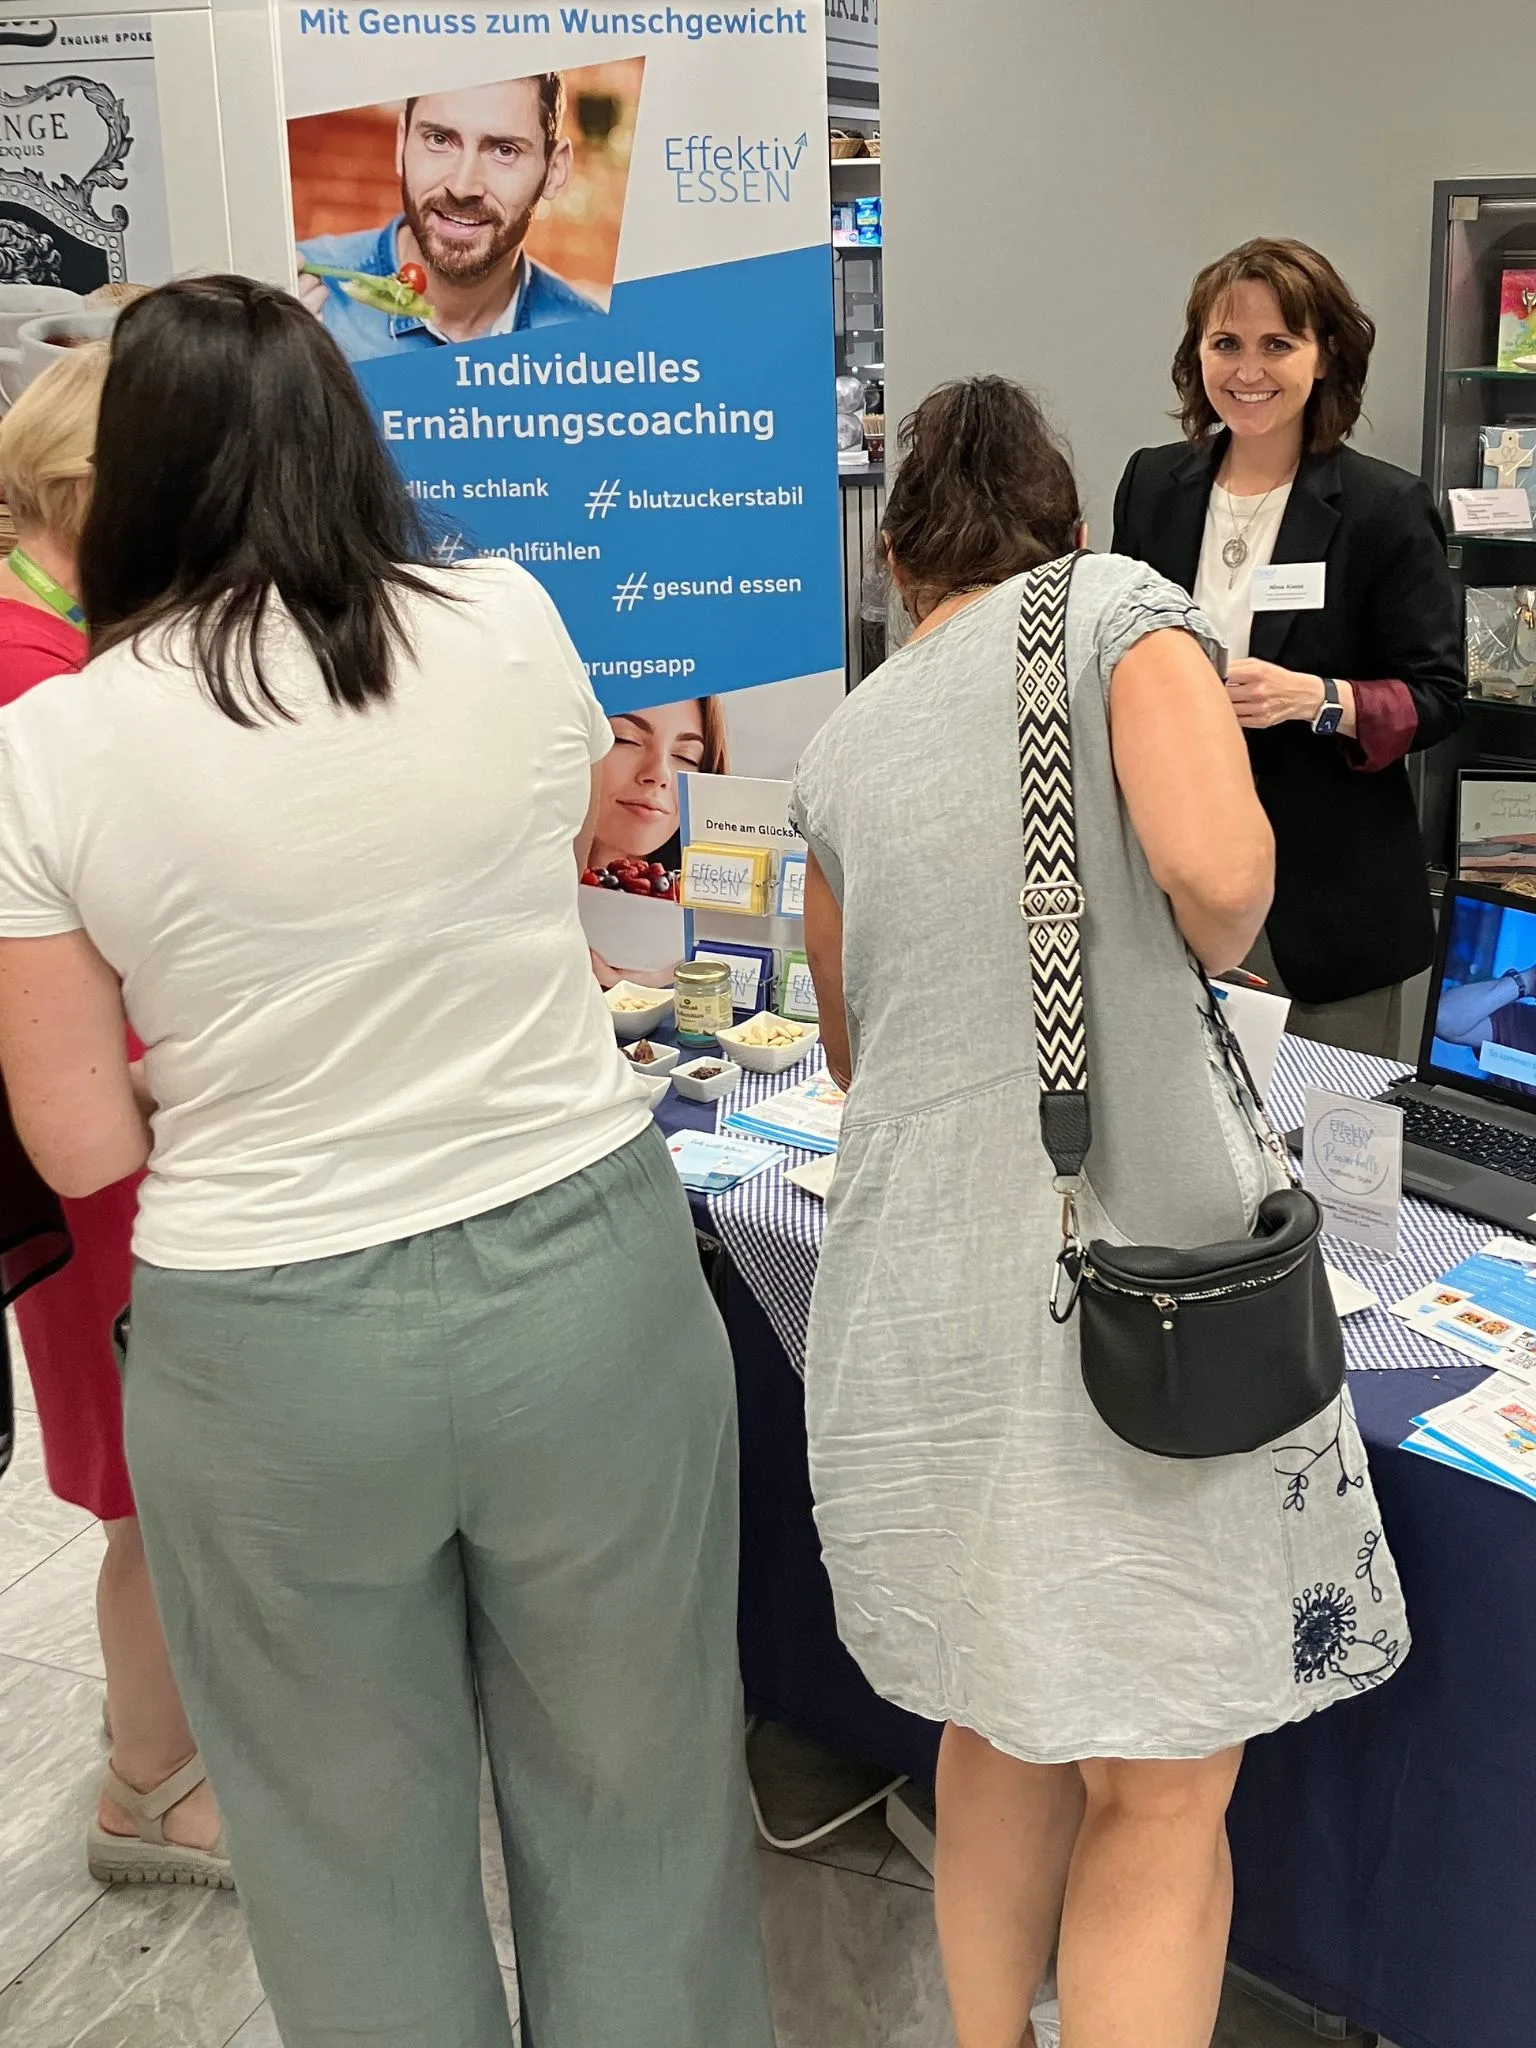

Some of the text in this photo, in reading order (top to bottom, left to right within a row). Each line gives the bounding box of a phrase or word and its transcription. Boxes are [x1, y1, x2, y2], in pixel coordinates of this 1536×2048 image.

[299, 7, 350, 35] Mit
[358, 8, 477, 35] Genuss
[485, 13, 550, 34] zum
[559, 7, 807, 41] Wunschgewicht
[60, 34, 109, 46] ENGLISH
[0, 113, 69, 141] NGE
[665, 133, 807, 171] Effektiv
[676, 170, 790, 203] ESSEN
[454, 351, 701, 387] Individuelles
[382, 402, 774, 445] Ernährungscoaching
[404, 478, 549, 499] dlich schlank
[628, 485, 804, 509] blutzuckerstabil
[652, 575, 733, 600] gesund
[739, 577, 802, 594] essen
[705, 819, 737, 832] Drehe
[739, 825, 756, 834] am
[690, 863, 748, 884] Effektiv
[693, 879, 740, 897] ESSEN
